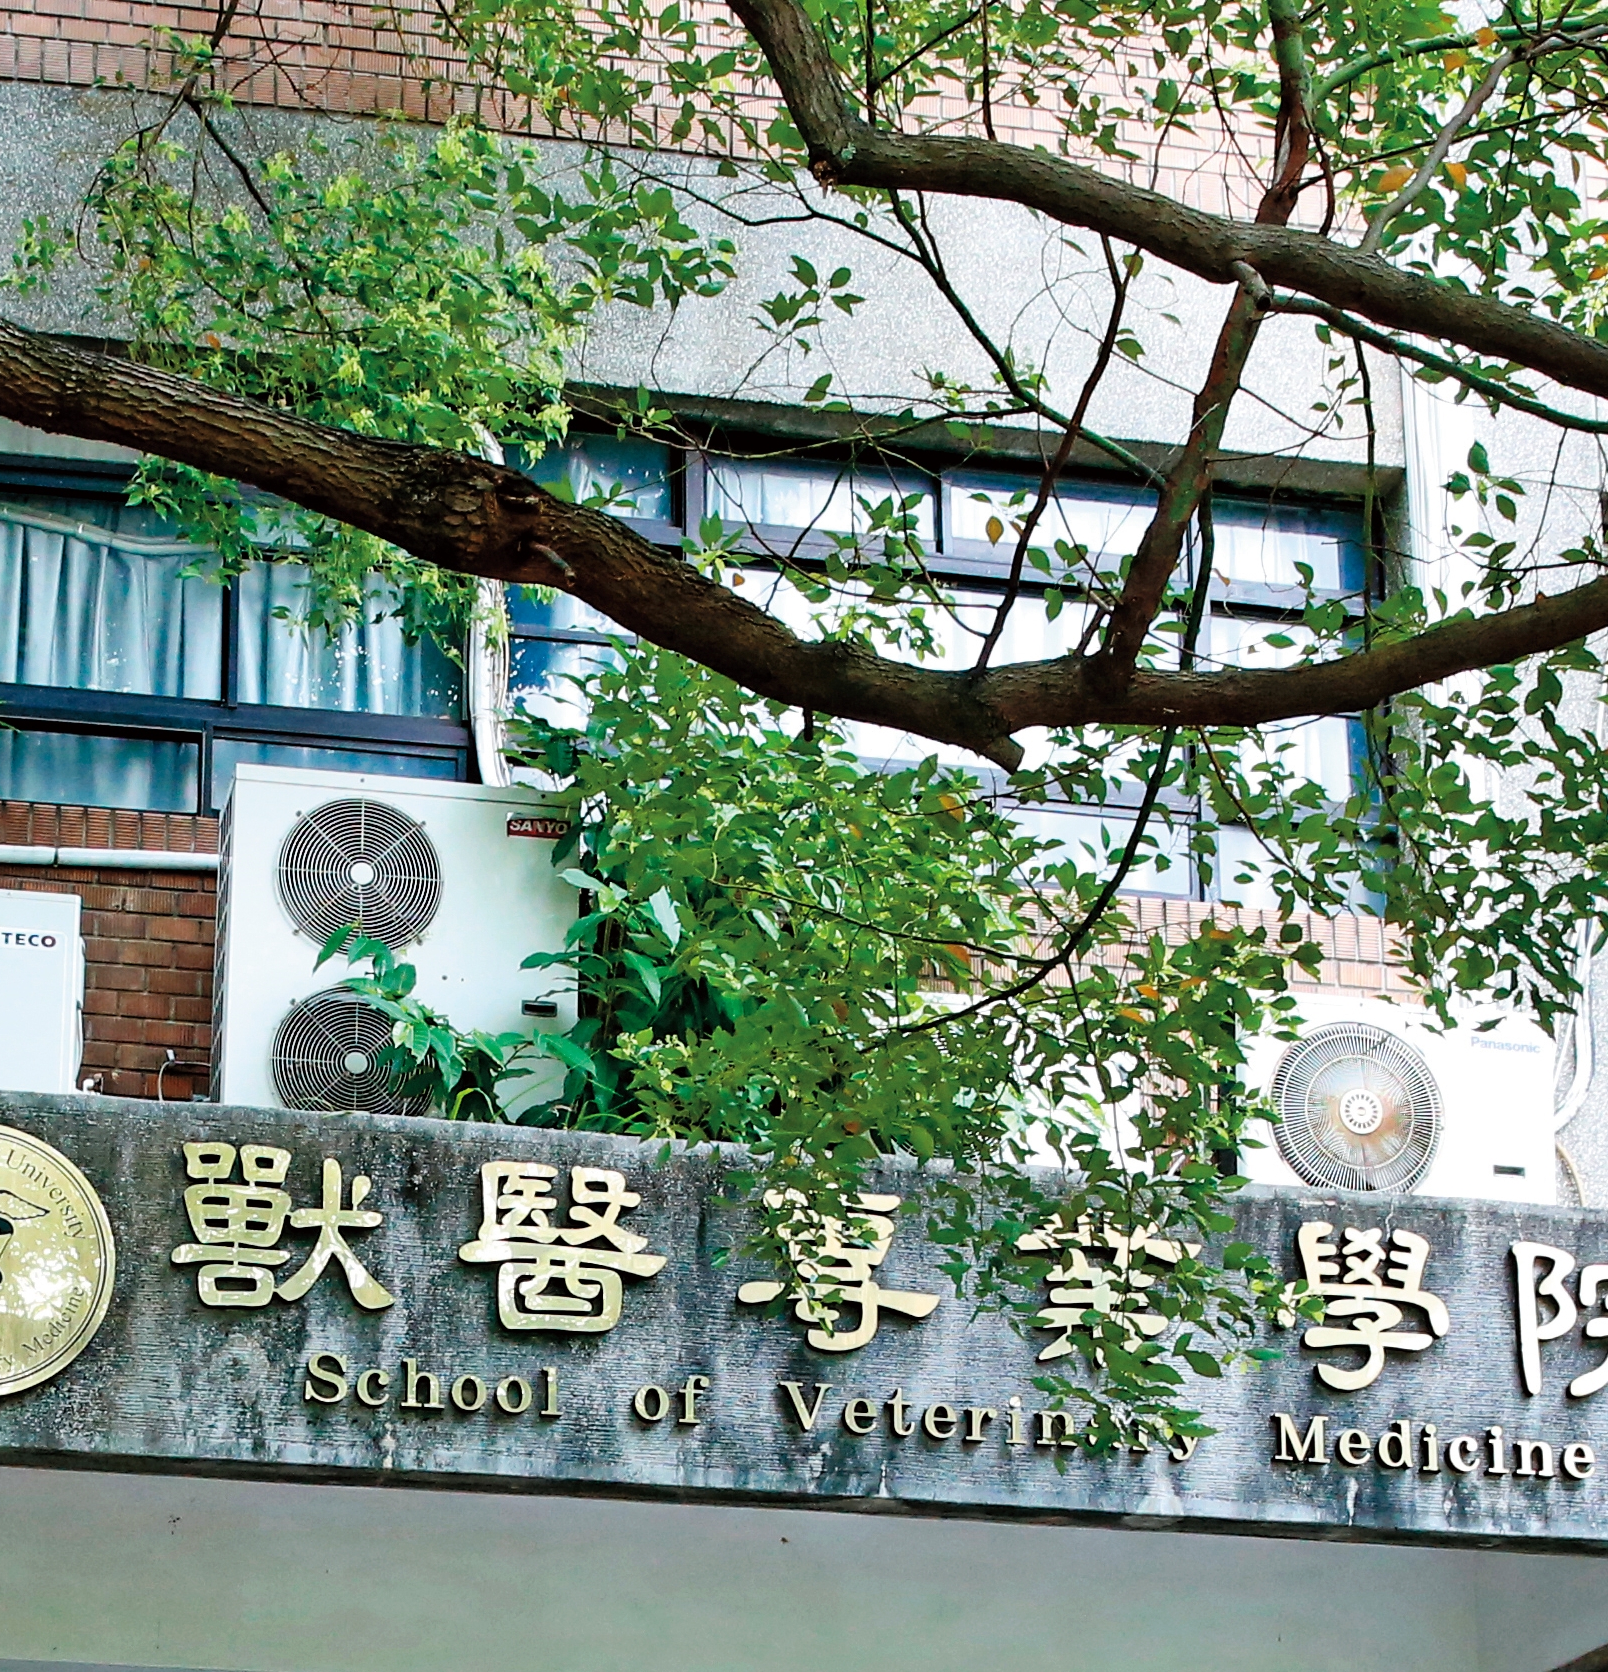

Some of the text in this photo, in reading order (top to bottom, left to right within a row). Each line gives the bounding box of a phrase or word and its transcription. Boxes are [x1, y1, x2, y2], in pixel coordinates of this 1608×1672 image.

[509, 820, 568, 834] SANYO
[1, 932, 56, 948] TECO
[1471, 1036, 1541, 1053] Panasonic
[6, 1148, 87, 1241] University
[21, 1285, 87, 1359] Medicine
[303, 1350, 563, 1419] School
[633, 1374, 711, 1425] of
[1273, 1411, 1597, 1481] Medicine
